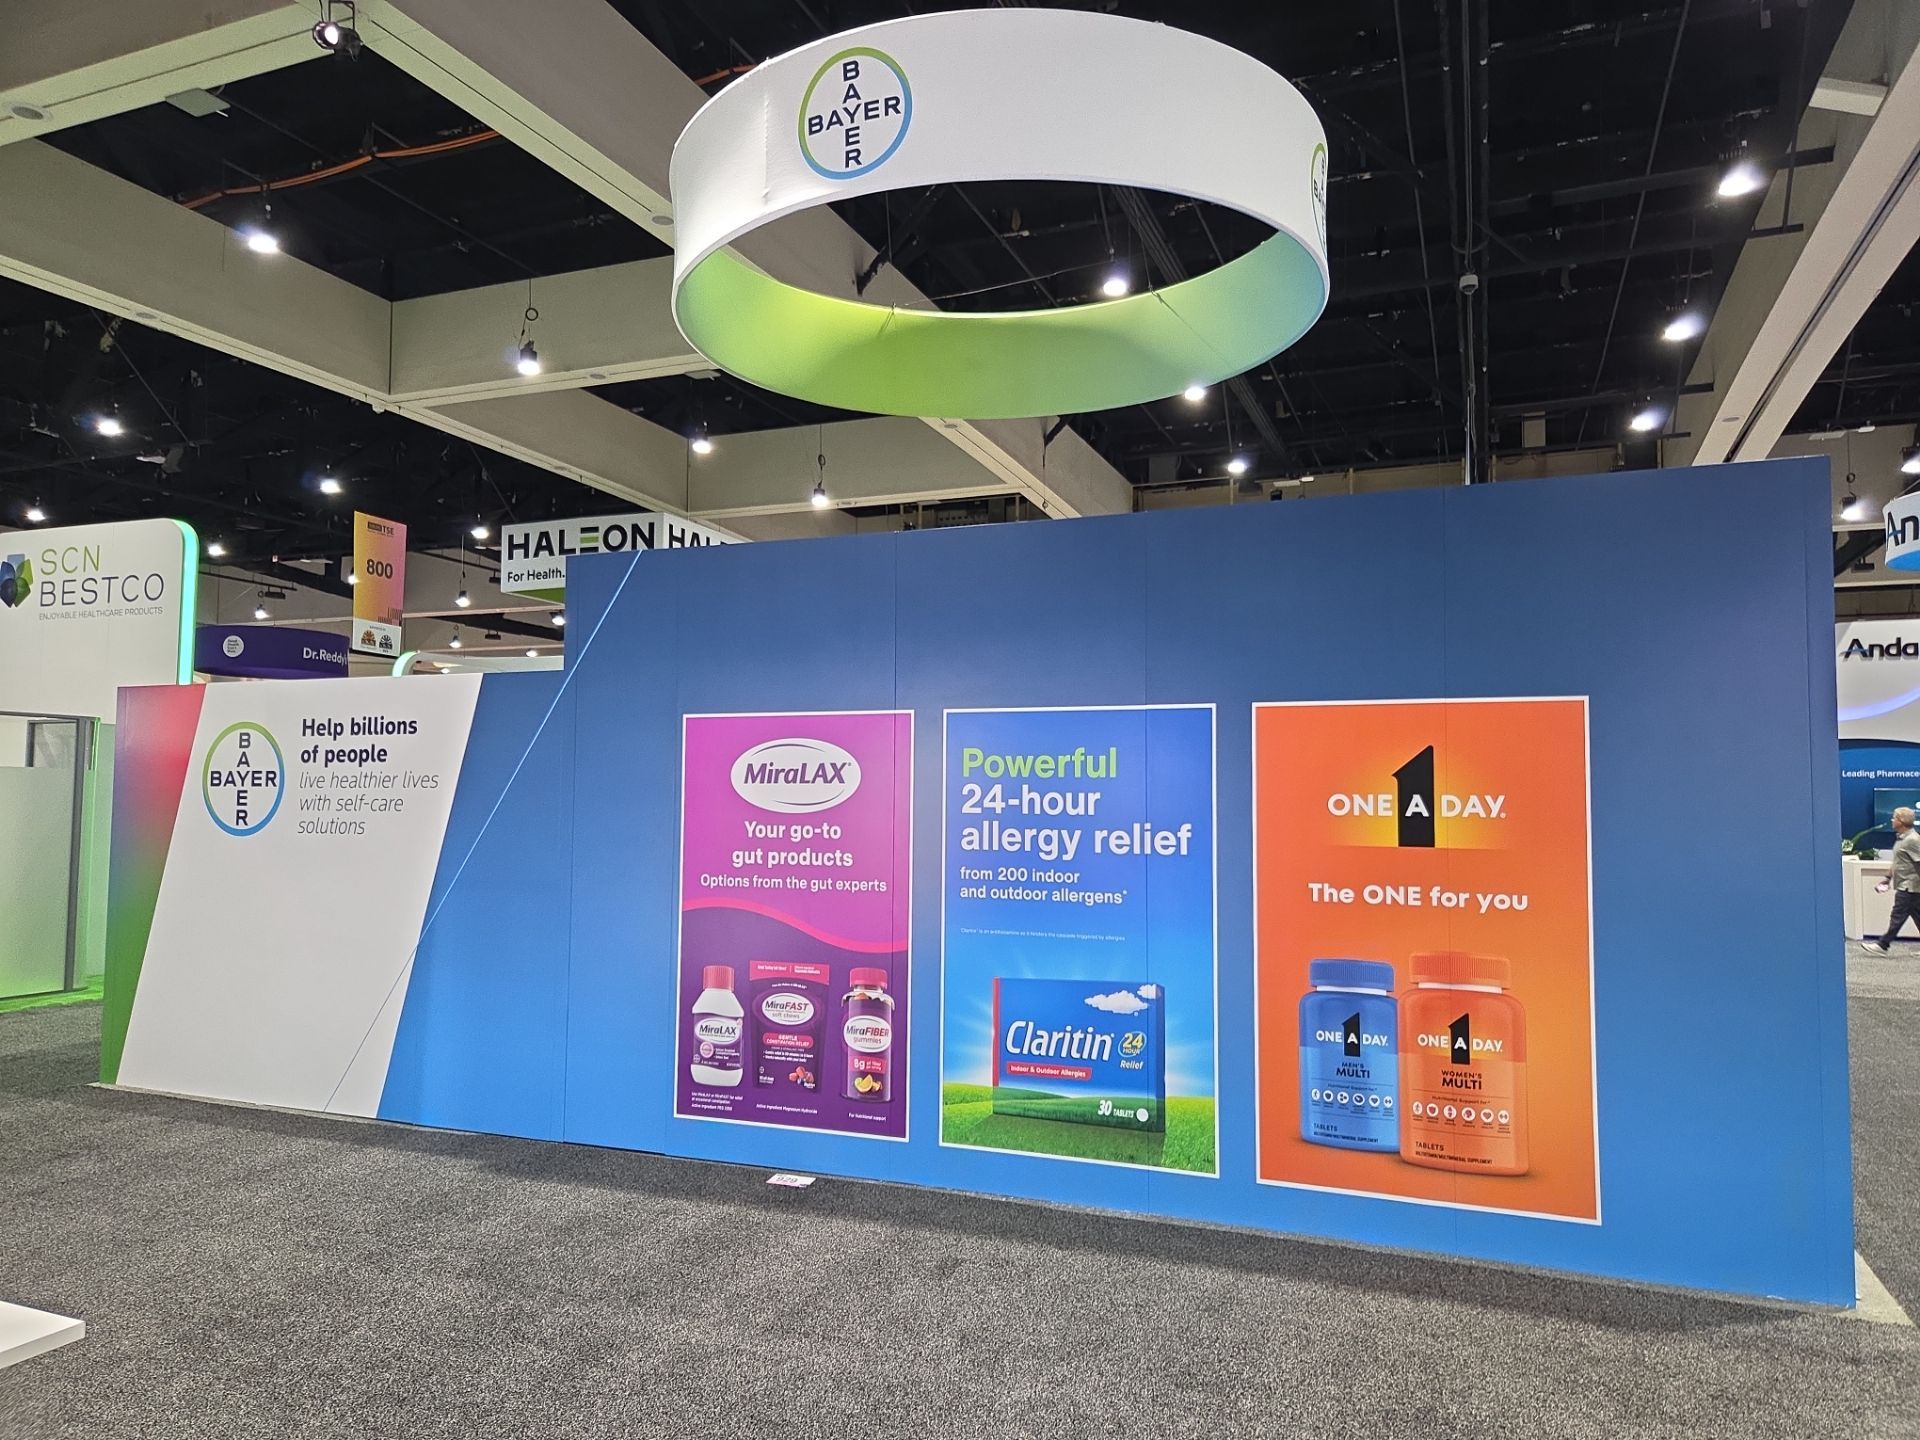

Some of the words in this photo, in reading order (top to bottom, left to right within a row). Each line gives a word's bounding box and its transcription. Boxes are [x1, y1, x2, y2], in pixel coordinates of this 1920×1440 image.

[808, 96, 901, 136] BAYER
[842, 60, 862, 168] BAYER
[507, 522, 655, 560] HALEON
[40, 545, 100, 575] SCN
[367, 558, 393, 579] 800
[507, 571, 524, 583] For
[40, 573, 164, 607] BESTCO
[39, 610, 77, 621] ENJOYABLE
[78, 608, 123, 619] HEALTHCARE
[125, 606, 163, 617] PRODUCTS
[302, 718, 344, 741] Help
[350, 716, 418, 736] billions
[300, 745, 319, 763] of
[324, 744, 388, 767] people
[962, 747, 1117, 778] Powerful
[210, 770, 278, 787] BAYER
[236, 732, 252, 826] BAYER
[299, 772, 326, 789] live
[330, 771, 398, 789] healthier
[402, 770, 439, 789] lives
[744, 762, 847, 784] MiraLAX
[1842, 769, 1875, 779] Leading
[300, 795, 330, 812] with
[336, 794, 404, 812] self-care
[961, 783, 1101, 816] 24-hour
[1327, 793, 1393, 816] ONE
[1405, 794, 1429, 817] A
[297, 817, 366, 835] solutions
[744, 821, 786, 839] Your
[790, 823, 842, 842] go-to
[960, 820, 1081, 861] allergy
[1094, 823, 1192, 855] relief
[731, 850, 763, 868] gut
[768, 848, 854, 868] products
[700, 874, 749, 888] Options
[753, 875, 782, 888] from
[786, 876, 808, 889] the
[810, 879, 833, 892] gut
[835, 880, 887, 893] experts
[960, 867, 993, 881] from
[998, 868, 1027, 882] 200
[1032, 868, 1080, 883] indoor
[960, 885, 986, 898] and
[990, 887, 1047, 901] outdoor
[1308, 882, 1355, 903] The
[1363, 885, 1421, 906] ONE
[1430, 886, 1470, 910] for
[1476, 893, 1528, 913] you
[765, 1000, 809, 1011] MiraFAST
[699, 1024, 737, 1036] MiraLAX
[846, 1025, 890, 1037] MiraFIBER
[1316, 1030, 1343, 1042] ONE
[1347, 1033, 1358, 1044] A
[1006, 1020, 1113, 1061] Claritin
[1122, 1032, 1143, 1049] 24
[1417, 1034, 1449, 1048] ONE
[1454, 1036, 1467, 1050] A
[1036, 1067, 1060, 1075] Outdoor
[1061, 1070, 1086, 1078] Allergies
[1120, 1060, 1144, 1070] Relief
[1336, 1068, 1370, 1078] MULTI
[1441, 1070, 1482, 1079] WOMEN'S
[1441, 1077, 1482, 1090] MULTI
[1098, 1100, 1112, 1116] 30
[1113, 1108, 1134, 1118] TABLETS
[1415, 1141, 1444, 1151] TABLETS
